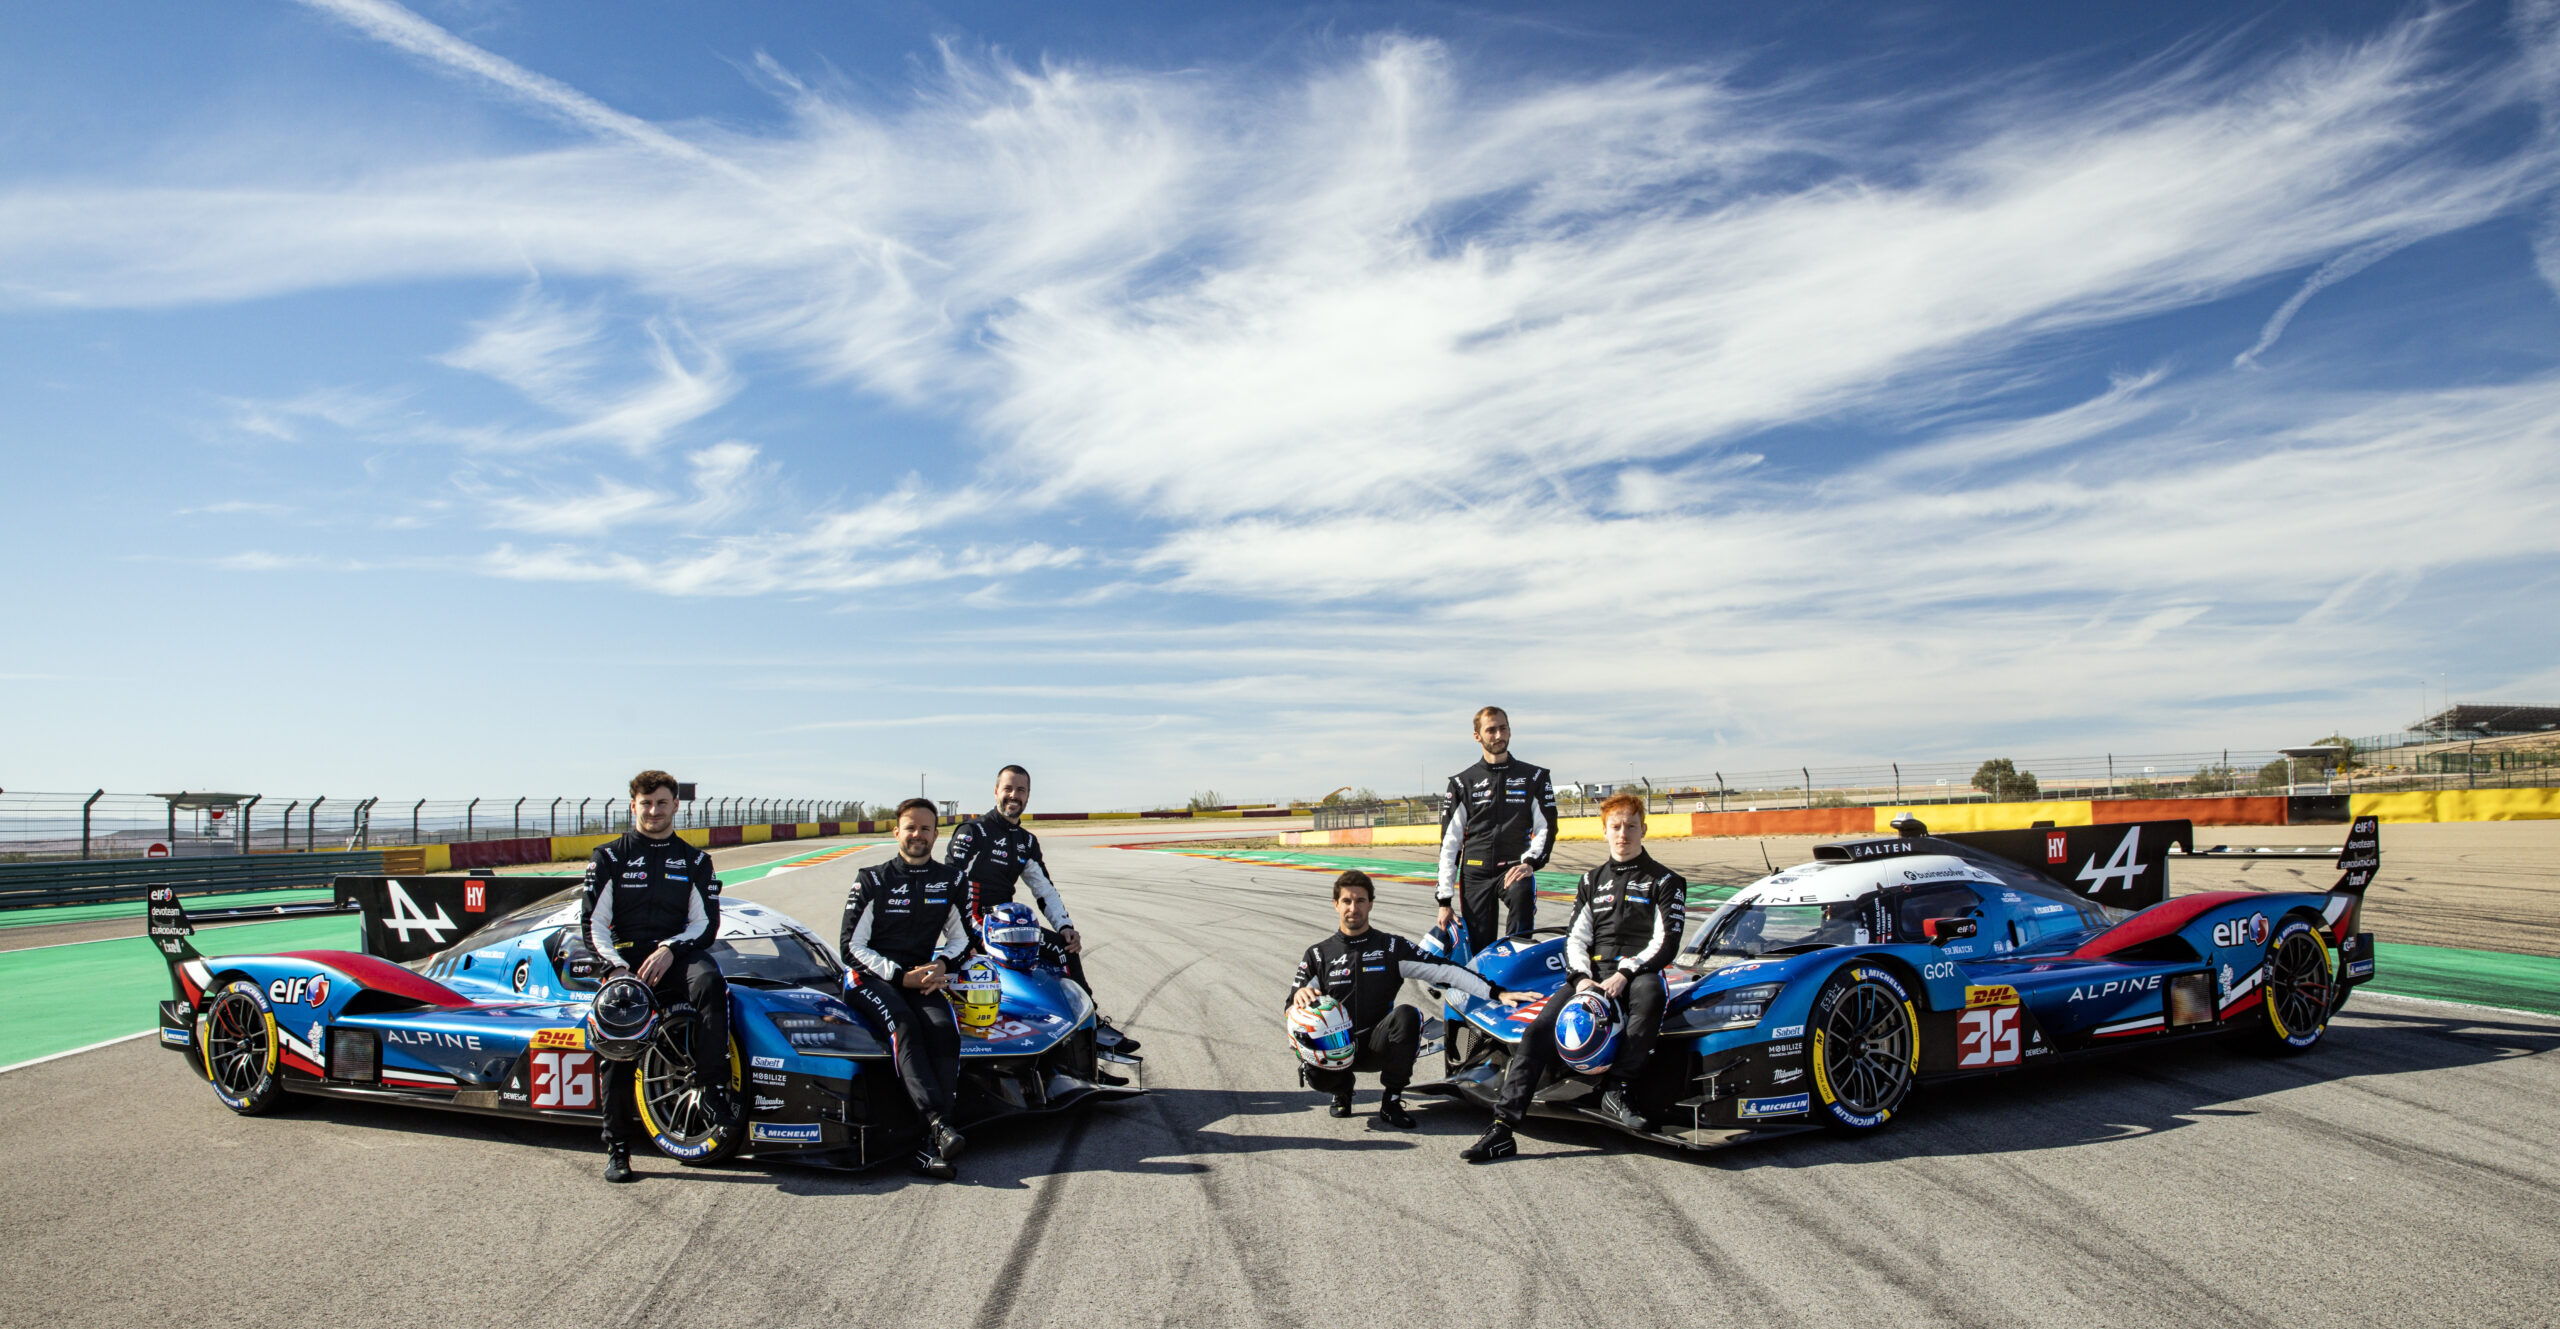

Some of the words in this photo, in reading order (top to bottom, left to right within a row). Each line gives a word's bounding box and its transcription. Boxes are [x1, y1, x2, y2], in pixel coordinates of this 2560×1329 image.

[2354, 822, 2368, 832] elf
[1864, 843, 1912, 855] ALTEN
[2048, 838, 2064, 858] HY
[2348, 840, 2376, 849] devoteam
[2341, 859, 2377, 869] EURODATACAR
[151, 890, 164, 900] elf
[467, 887, 484, 906] HY
[152, 907, 180, 916] devoteam
[152, 927, 190, 935] EURODATACAR
[1957, 924, 1969, 933] elf
[2213, 919, 2248, 947] elf
[572, 965, 584, 973] elf
[1329, 969, 1344, 977] elf
[1924, 962, 1954, 980] GCR
[1868, 969, 1906, 997] MICHELIN
[2067, 975, 2162, 1002] ALPINE
[240, 984, 268, 1010] MICHELIN
[270, 979, 307, 1003] elf
[1973, 987, 2013, 1003] DHL
[860, 988, 896, 1032] ALPINE
[537, 1031, 578, 1046] DHL
[1776, 1026, 1801, 1038] Sabelt
[1959, 1007, 2019, 1065] 35
[388, 1030, 482, 1050] ALPINE
[754, 1057, 780, 1068] Sabelt
[532, 1053, 593, 1106] 36
[1760, 1100, 1807, 1112] MICHELIN
[1833, 1105, 1876, 1126] MICHELIN
[768, 1130, 818, 1138] MICHELIN
[660, 1138, 701, 1156] MICHELIN
